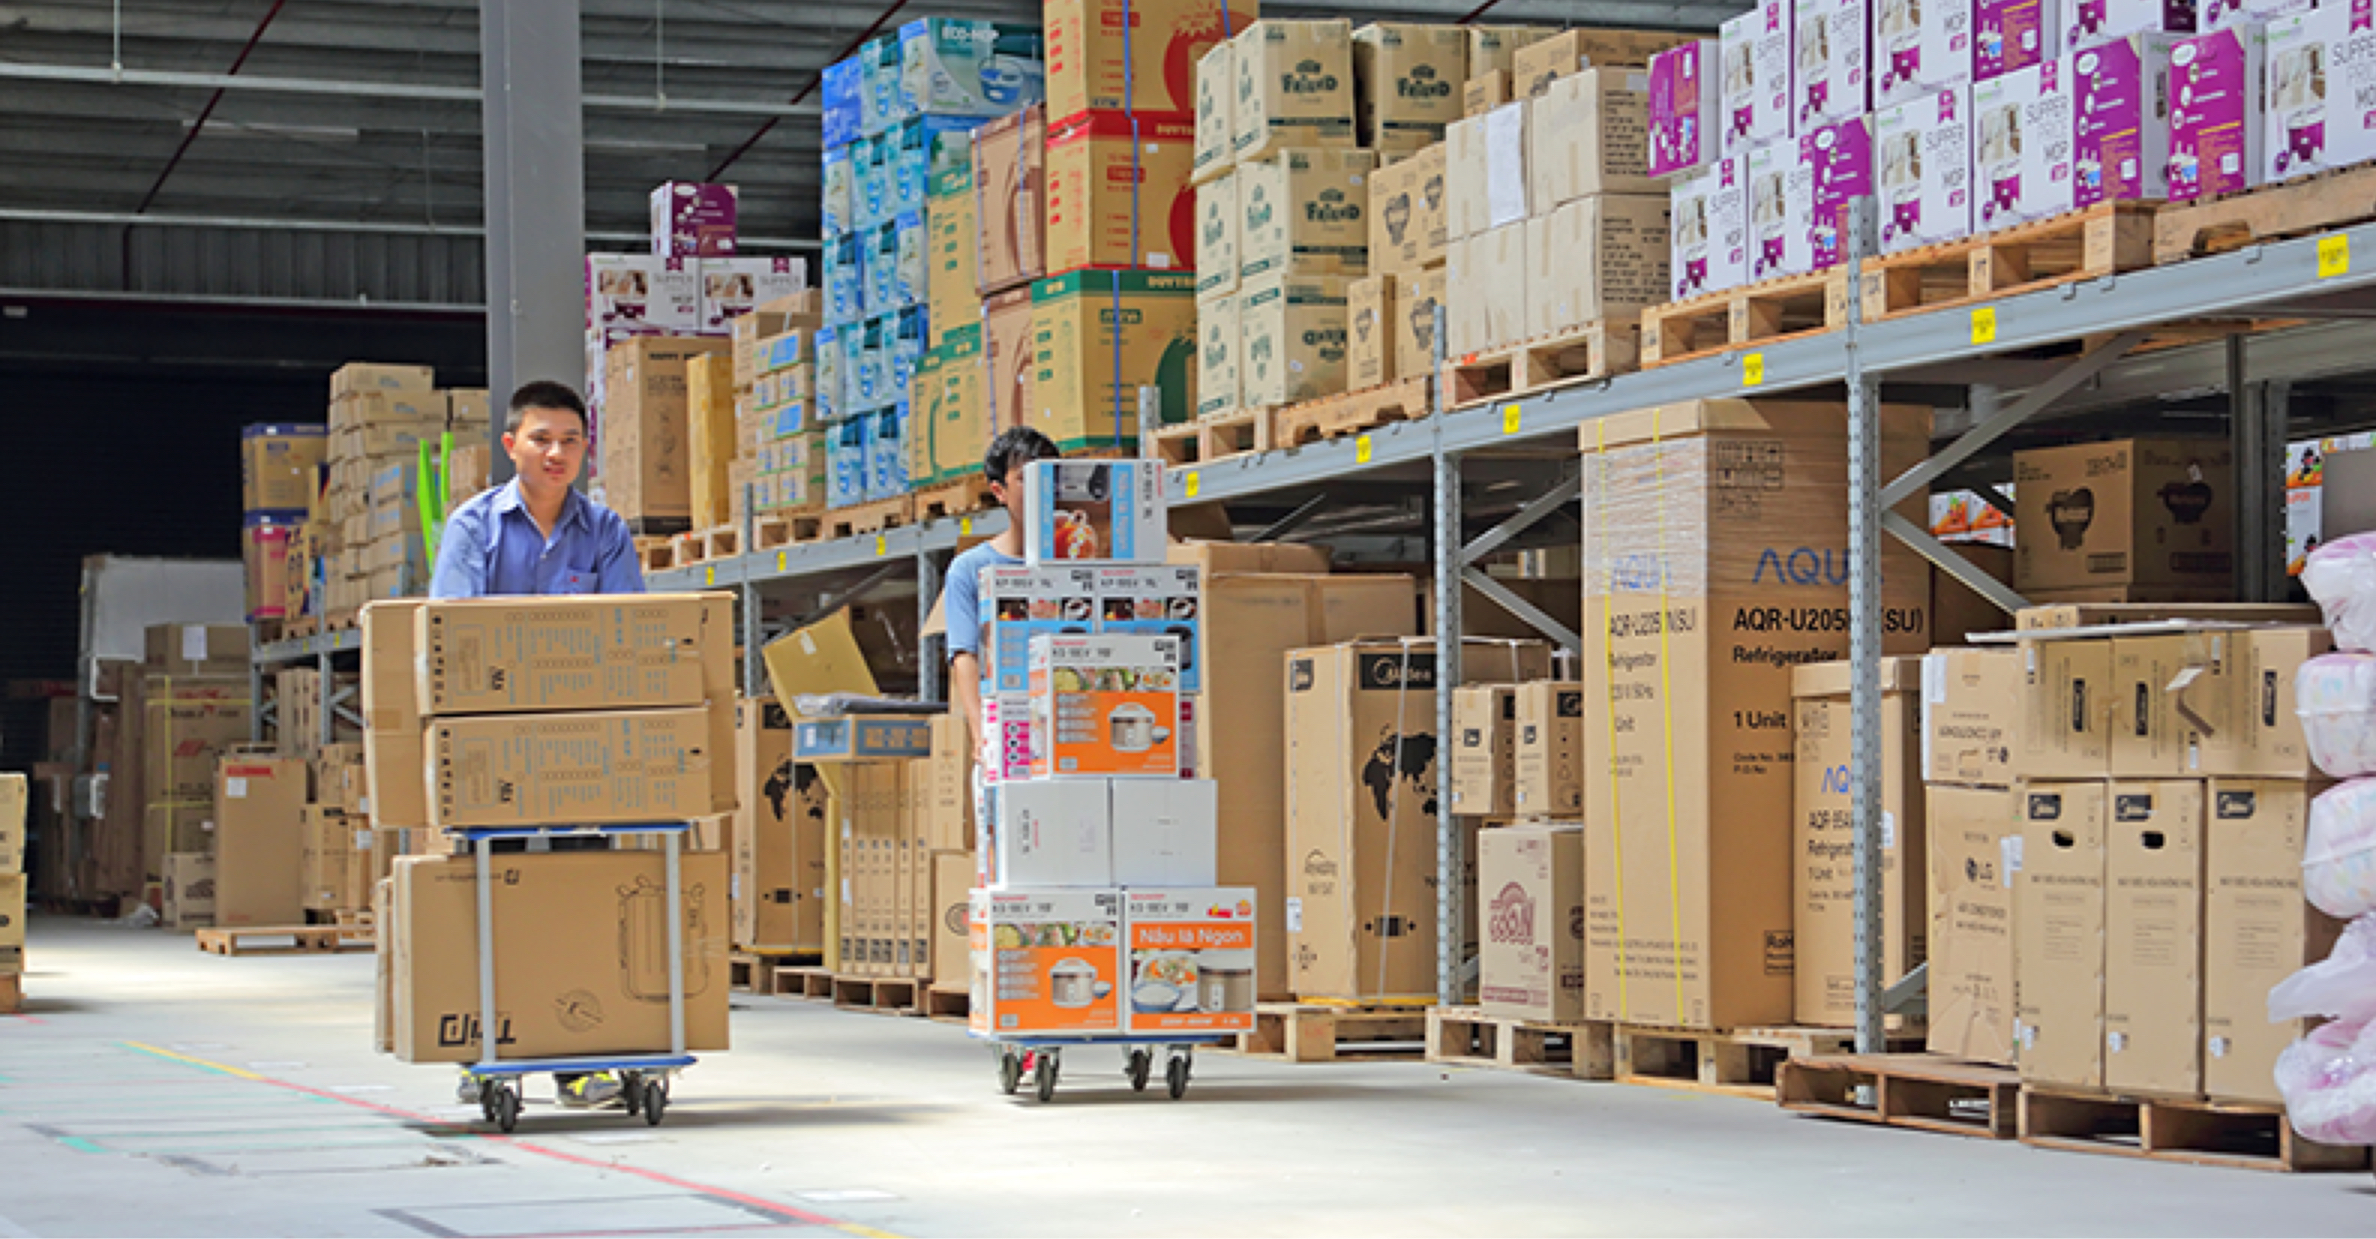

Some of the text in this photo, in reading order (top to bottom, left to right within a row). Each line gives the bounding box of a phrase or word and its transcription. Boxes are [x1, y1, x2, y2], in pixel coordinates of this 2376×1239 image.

[1752, 547, 1884, 586] AQU
[1746, 711, 1787, 729] Unit
[1197, 928, 1245, 945] Ngon
